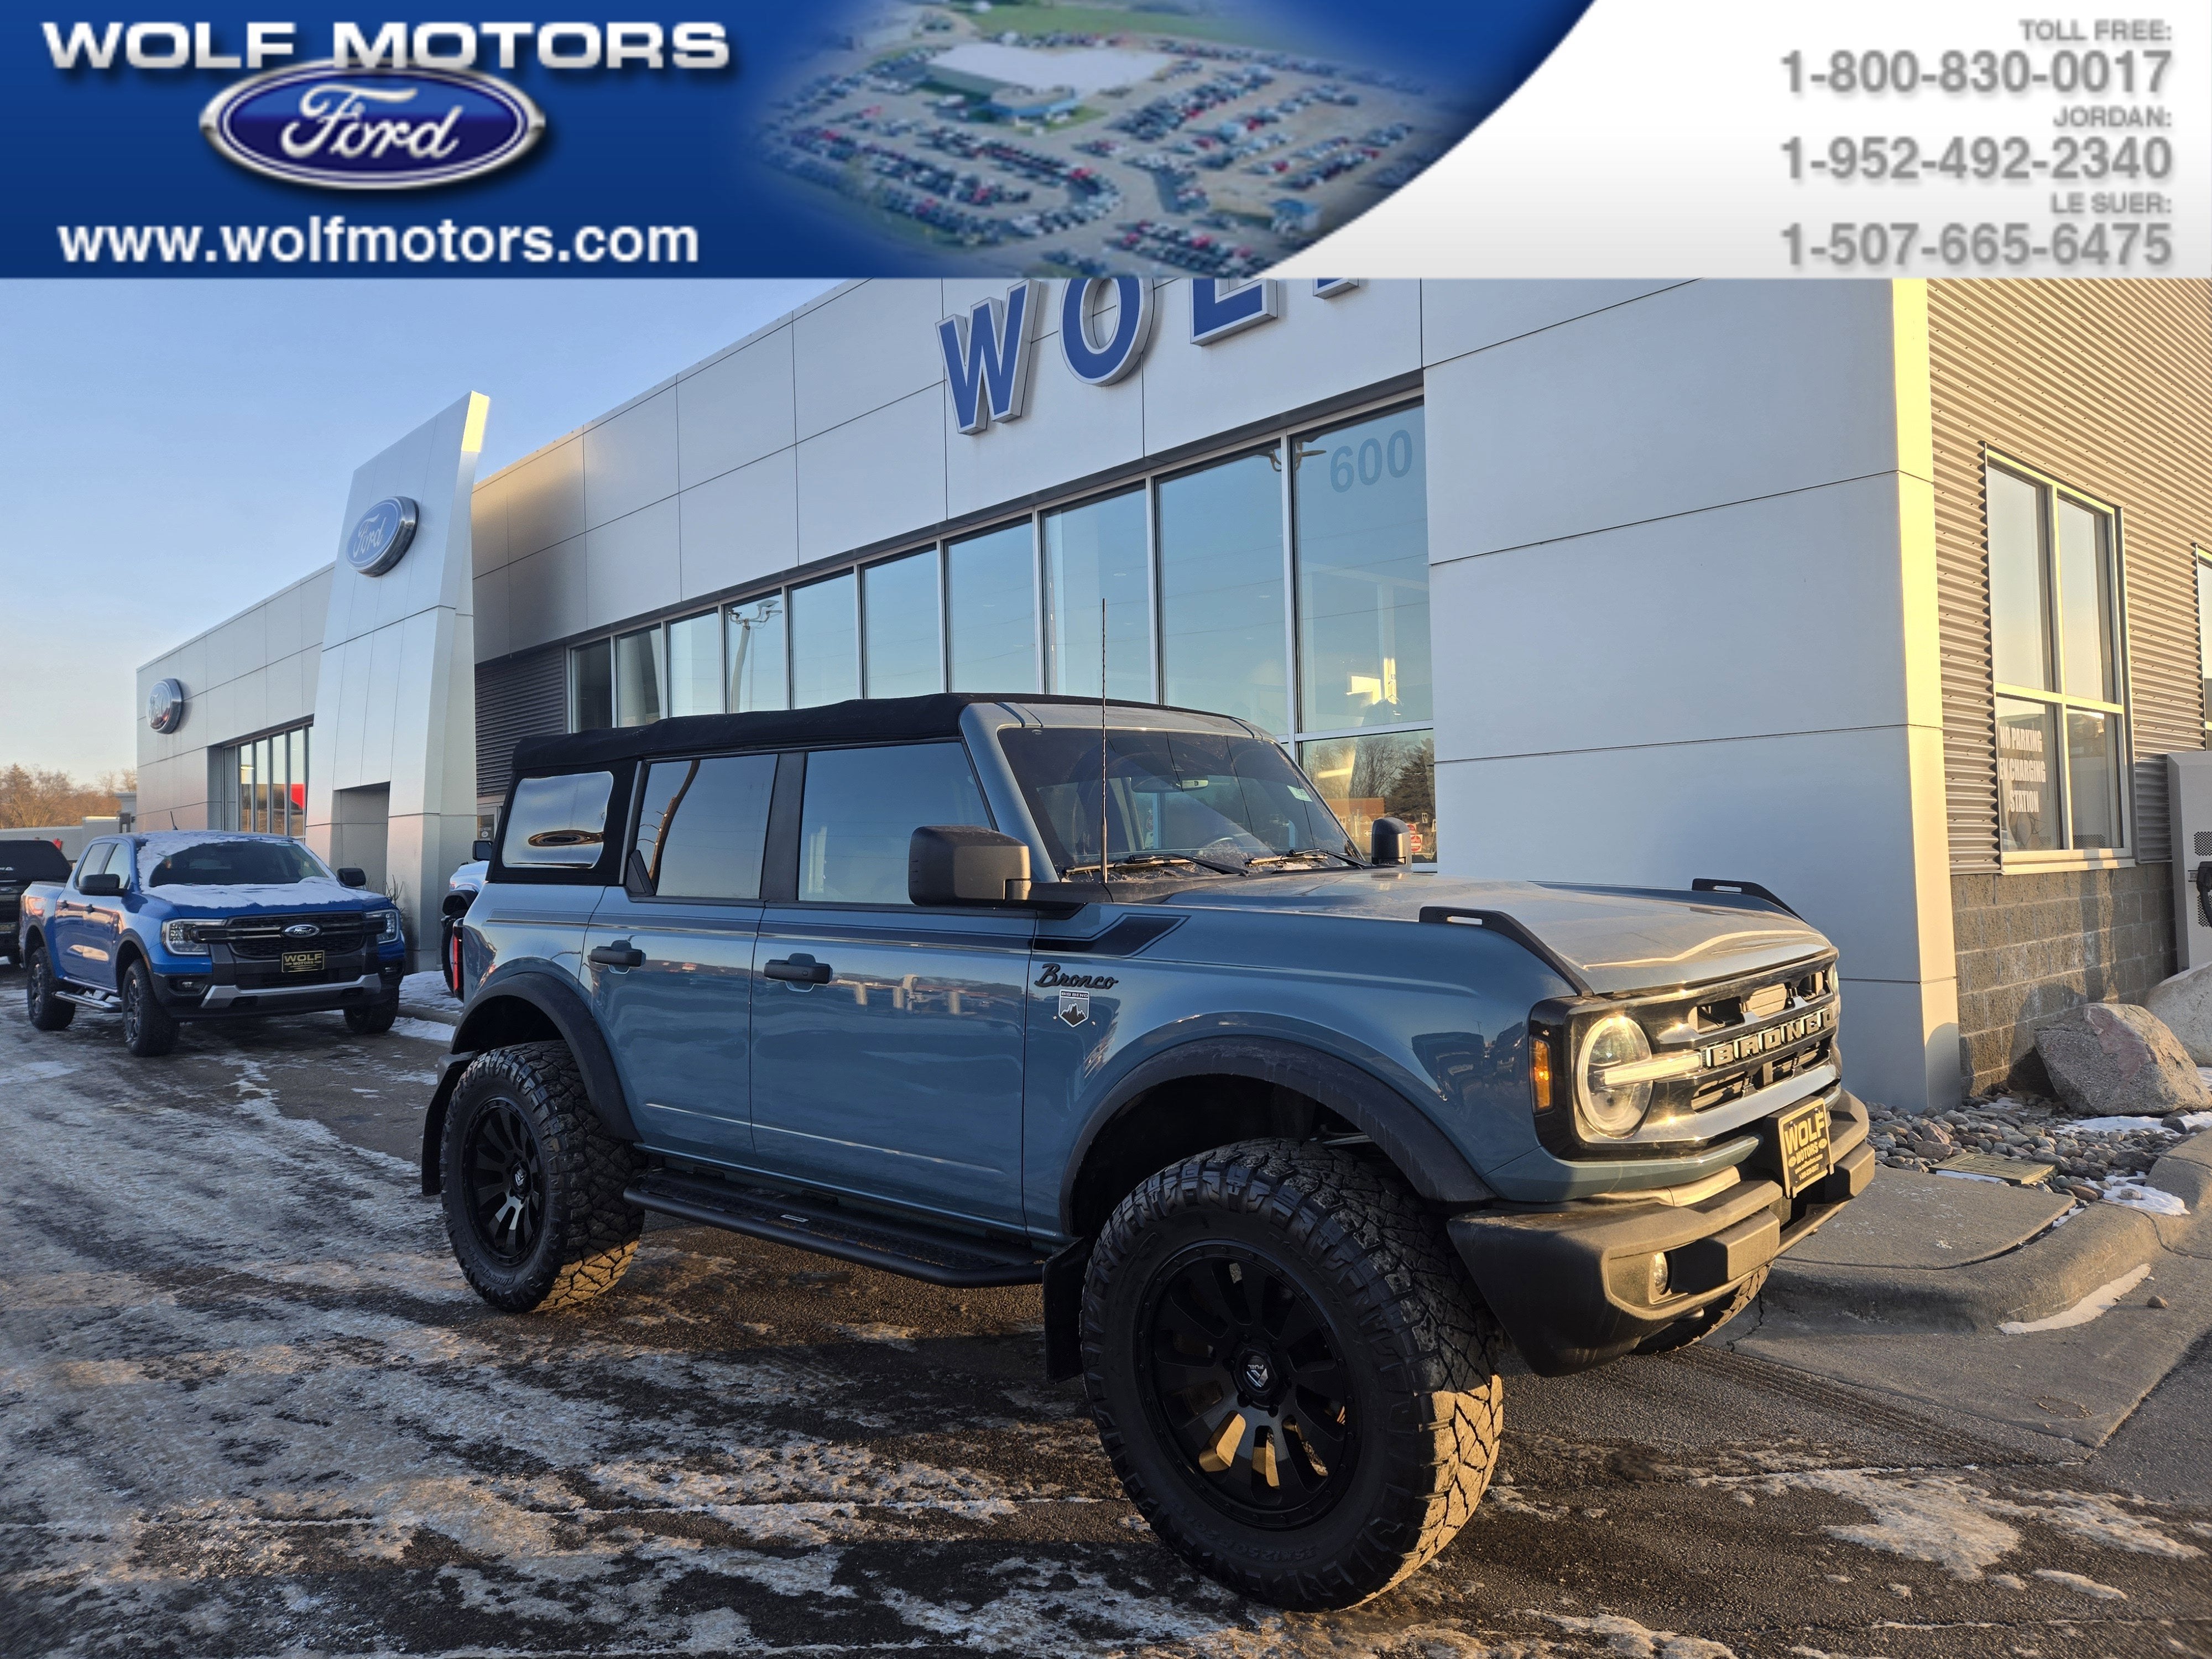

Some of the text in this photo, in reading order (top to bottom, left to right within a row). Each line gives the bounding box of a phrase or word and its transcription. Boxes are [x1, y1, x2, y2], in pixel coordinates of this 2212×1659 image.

[1329, 429, 1413, 493] 600
[353, 513, 387, 559] Ford
[2000, 726, 2043, 752] NO PARKING
[1999, 758, 2046, 782] EV CHARGING
[2010, 790, 2039, 812] STATION
[284, 953, 322, 962] WOLF
[1034, 963, 1119, 989] Bronco
[1712, 1008, 1833, 1067] BRONCO
[1784, 1111, 1825, 1155] WOLF
[1796, 1141, 1819, 1164] MOTORS
